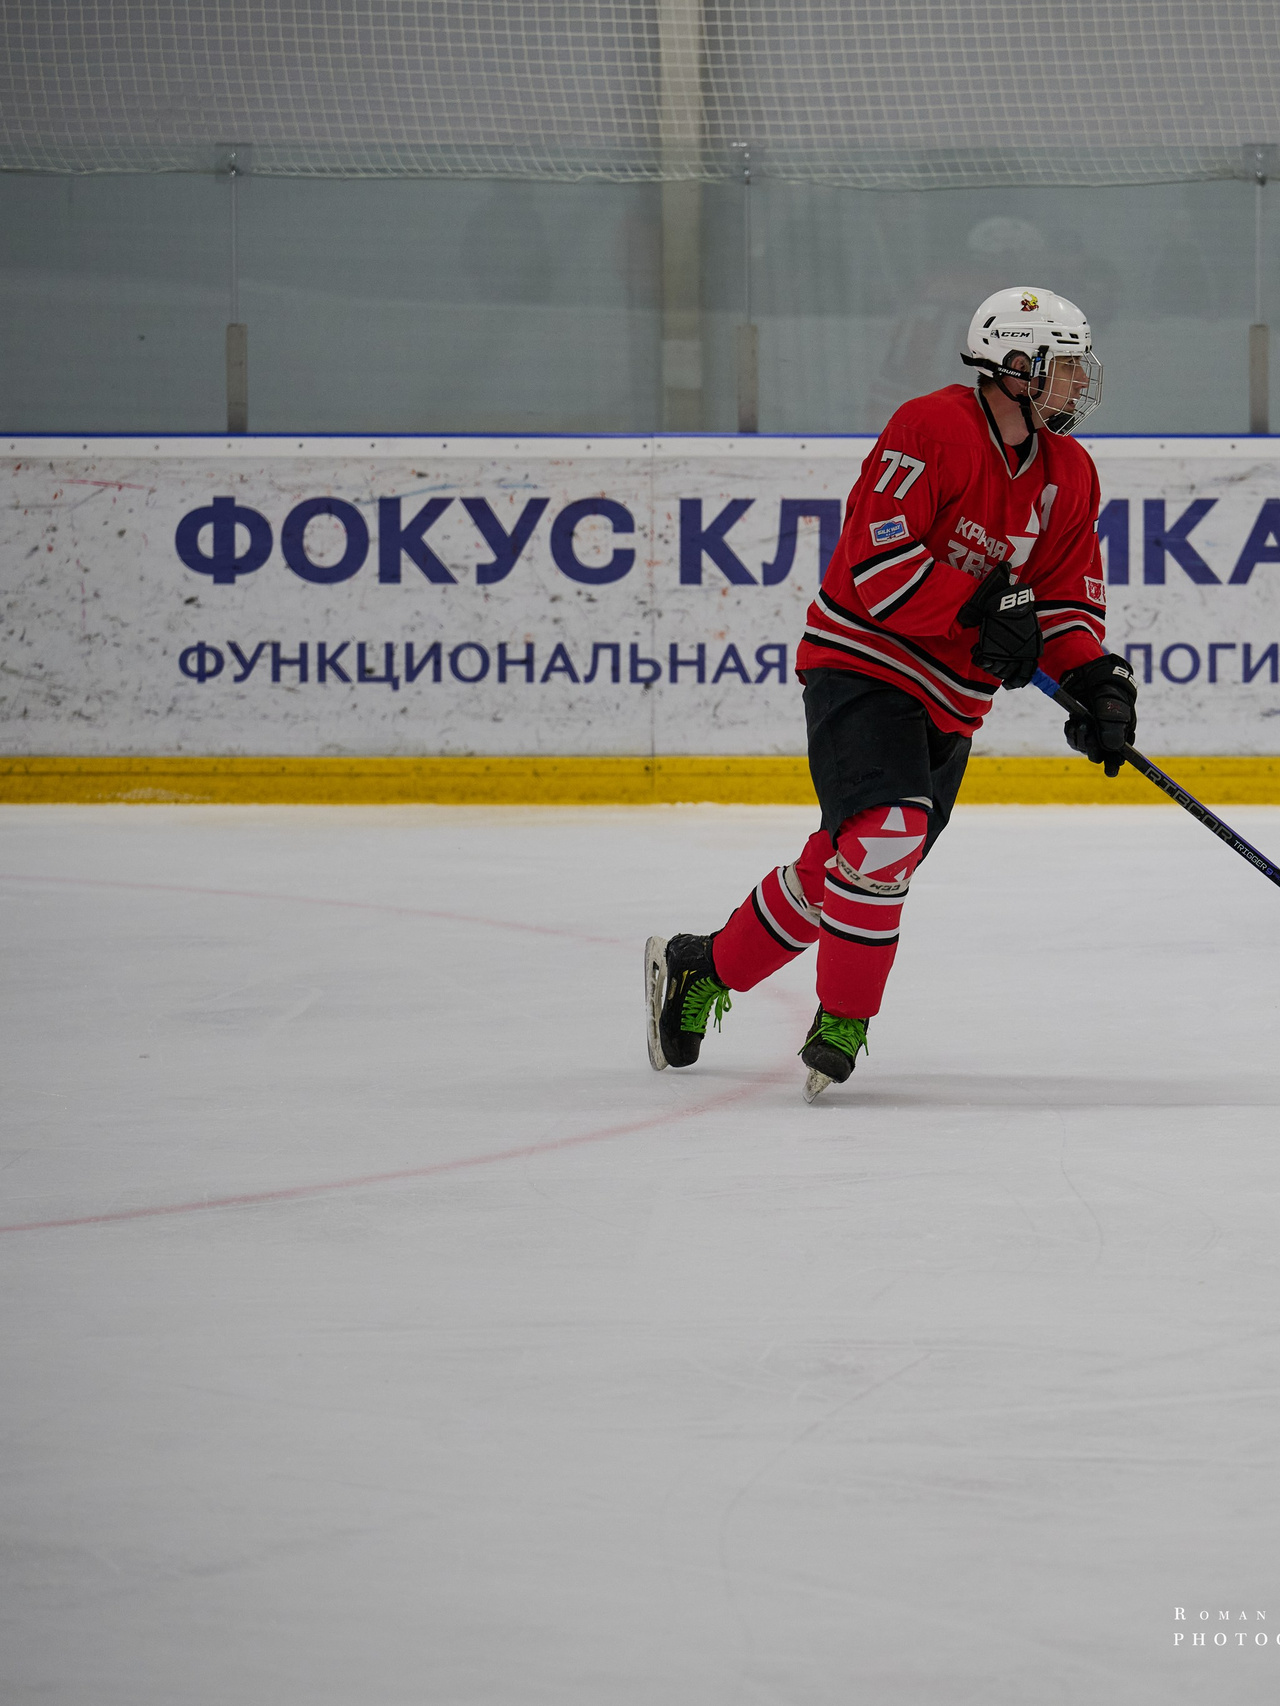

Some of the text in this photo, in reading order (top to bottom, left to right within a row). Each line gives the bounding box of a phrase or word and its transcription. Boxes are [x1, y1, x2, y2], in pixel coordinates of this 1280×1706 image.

[873, 449, 926, 500] 77
[174, 495, 636, 586] ФОКУС
[177, 641, 788, 691] ФУНКЦИОНАЛЬНАЯ
[1145, 766, 1233, 842] RIBCOR
[1233, 839, 1268, 871] TRIGGER
[1265, 867, 1274, 876] 9
